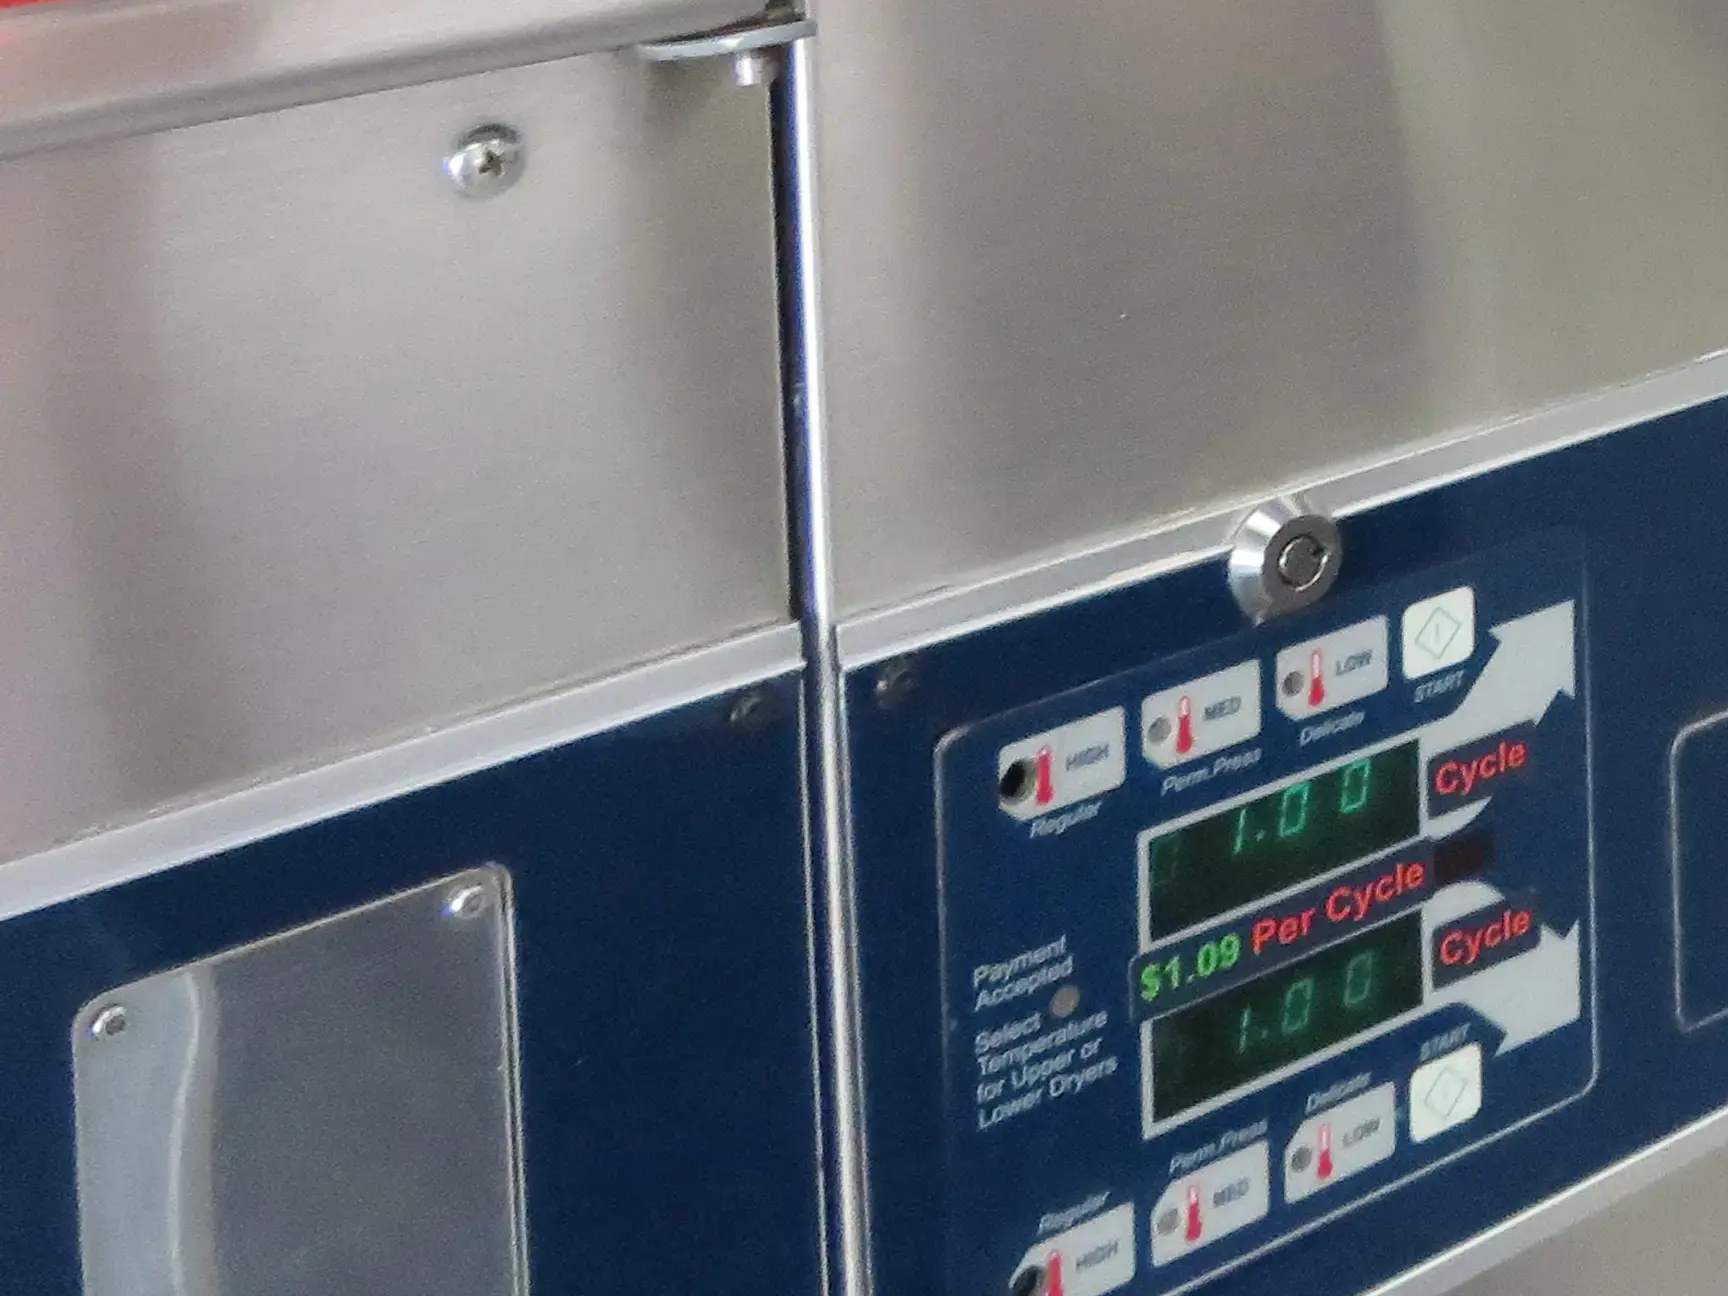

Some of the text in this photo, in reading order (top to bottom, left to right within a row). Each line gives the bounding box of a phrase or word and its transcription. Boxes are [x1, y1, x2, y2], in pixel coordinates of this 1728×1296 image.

[1335, 649, 1374, 677] LOW
[1414, 670, 1465, 704] START
[1203, 694, 1242, 721] MED
[1299, 711, 1365, 747] Delicate
[1065, 742, 1110, 772] HIGH
[1436, 741, 1527, 796] Cycle
[1029, 803, 1103, 839] Regular
[1139, 861, 1426, 1002] $1.09 Per Cycle
[1440, 908, 1533, 966] Cycle
[974, 934, 1067, 988] Payment
[975, 956, 1073, 1012] Accepted
[975, 1013, 1042, 1055] Select
[977, 1011, 1108, 1075] Temperature
[1421, 1022, 1470, 1061] START
[977, 1037, 1103, 1103] for Upper or
[978, 1056, 1119, 1130] Lower Dryers
[1342, 1119, 1381, 1146] LOW
[1214, 1178, 1251, 1207] MED
[1075, 1241, 1119, 1271] HIGH
